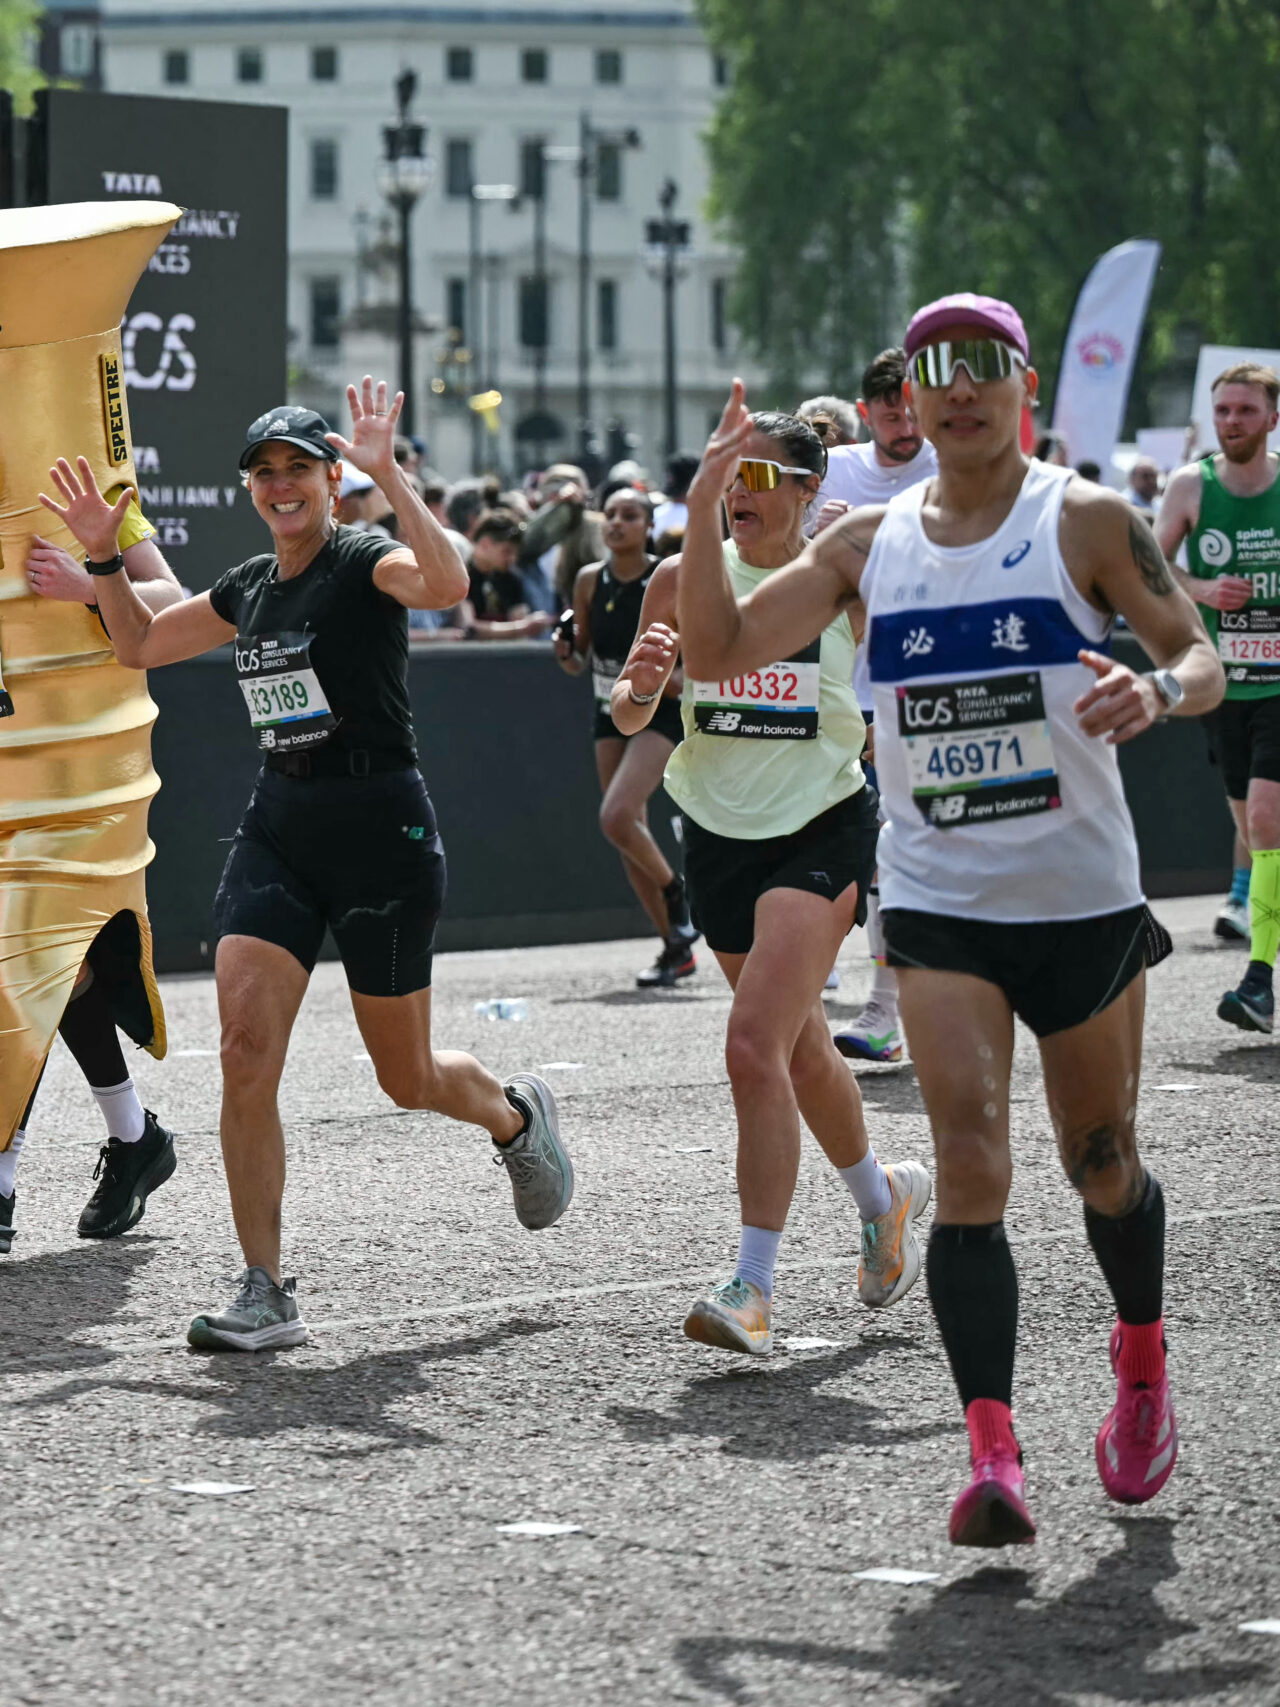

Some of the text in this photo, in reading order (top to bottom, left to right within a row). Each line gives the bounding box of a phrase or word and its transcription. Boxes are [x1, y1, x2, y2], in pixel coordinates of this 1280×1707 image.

[102, 171, 162, 194] TATA
[122, 311, 197, 391] cs
[106, 359, 127, 462] SPECTRE
[1236, 528, 1274, 543] Spinal
[261, 640, 278, 650] TATA
[261, 646, 304, 660] CONSULTANCY
[1229, 640, 1280, 659] 12768
[261, 658, 288, 669] SERVICES
[251, 680, 309, 715] 83189
[904, 686, 987, 727] tcs TATA
[956, 692, 1032, 710] CONSULTANCY
[958, 708, 1007, 722] SERVICES
[291, 729, 329, 744] balance
[741, 724, 761, 733] new
[763, 724, 807, 735] balance
[927, 735, 1023, 779] 46971
[968, 805, 993, 817] new
[995, 797, 1046, 814] balance
